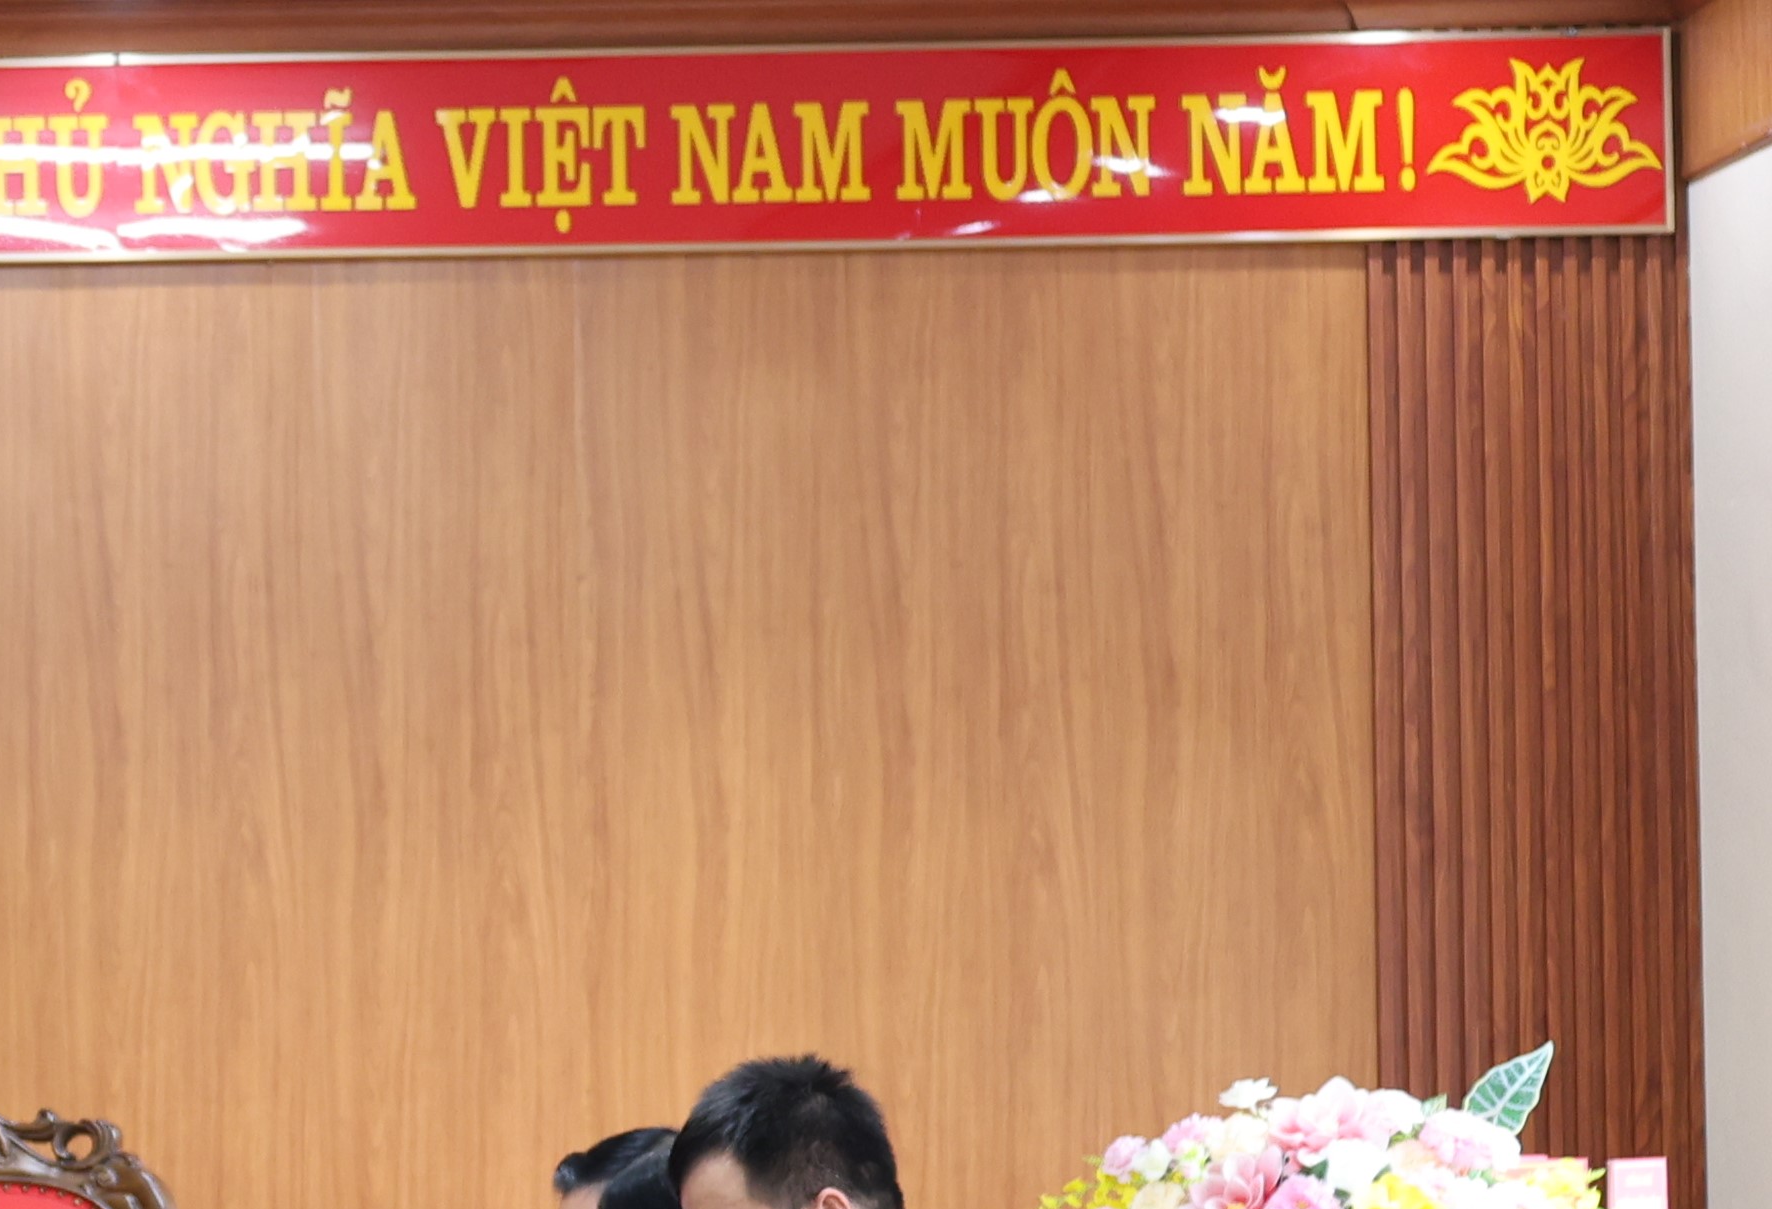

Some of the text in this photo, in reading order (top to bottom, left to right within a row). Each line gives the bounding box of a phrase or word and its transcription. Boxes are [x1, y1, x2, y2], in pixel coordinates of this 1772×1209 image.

[133, 88, 417, 213] NGHĨA
[436, 78, 646, 234] VIỆT
[670, 101, 871, 205] NAM
[895, 69, 1156, 201] MUÔN
[1182, 66, 1416, 196] NĂM!
